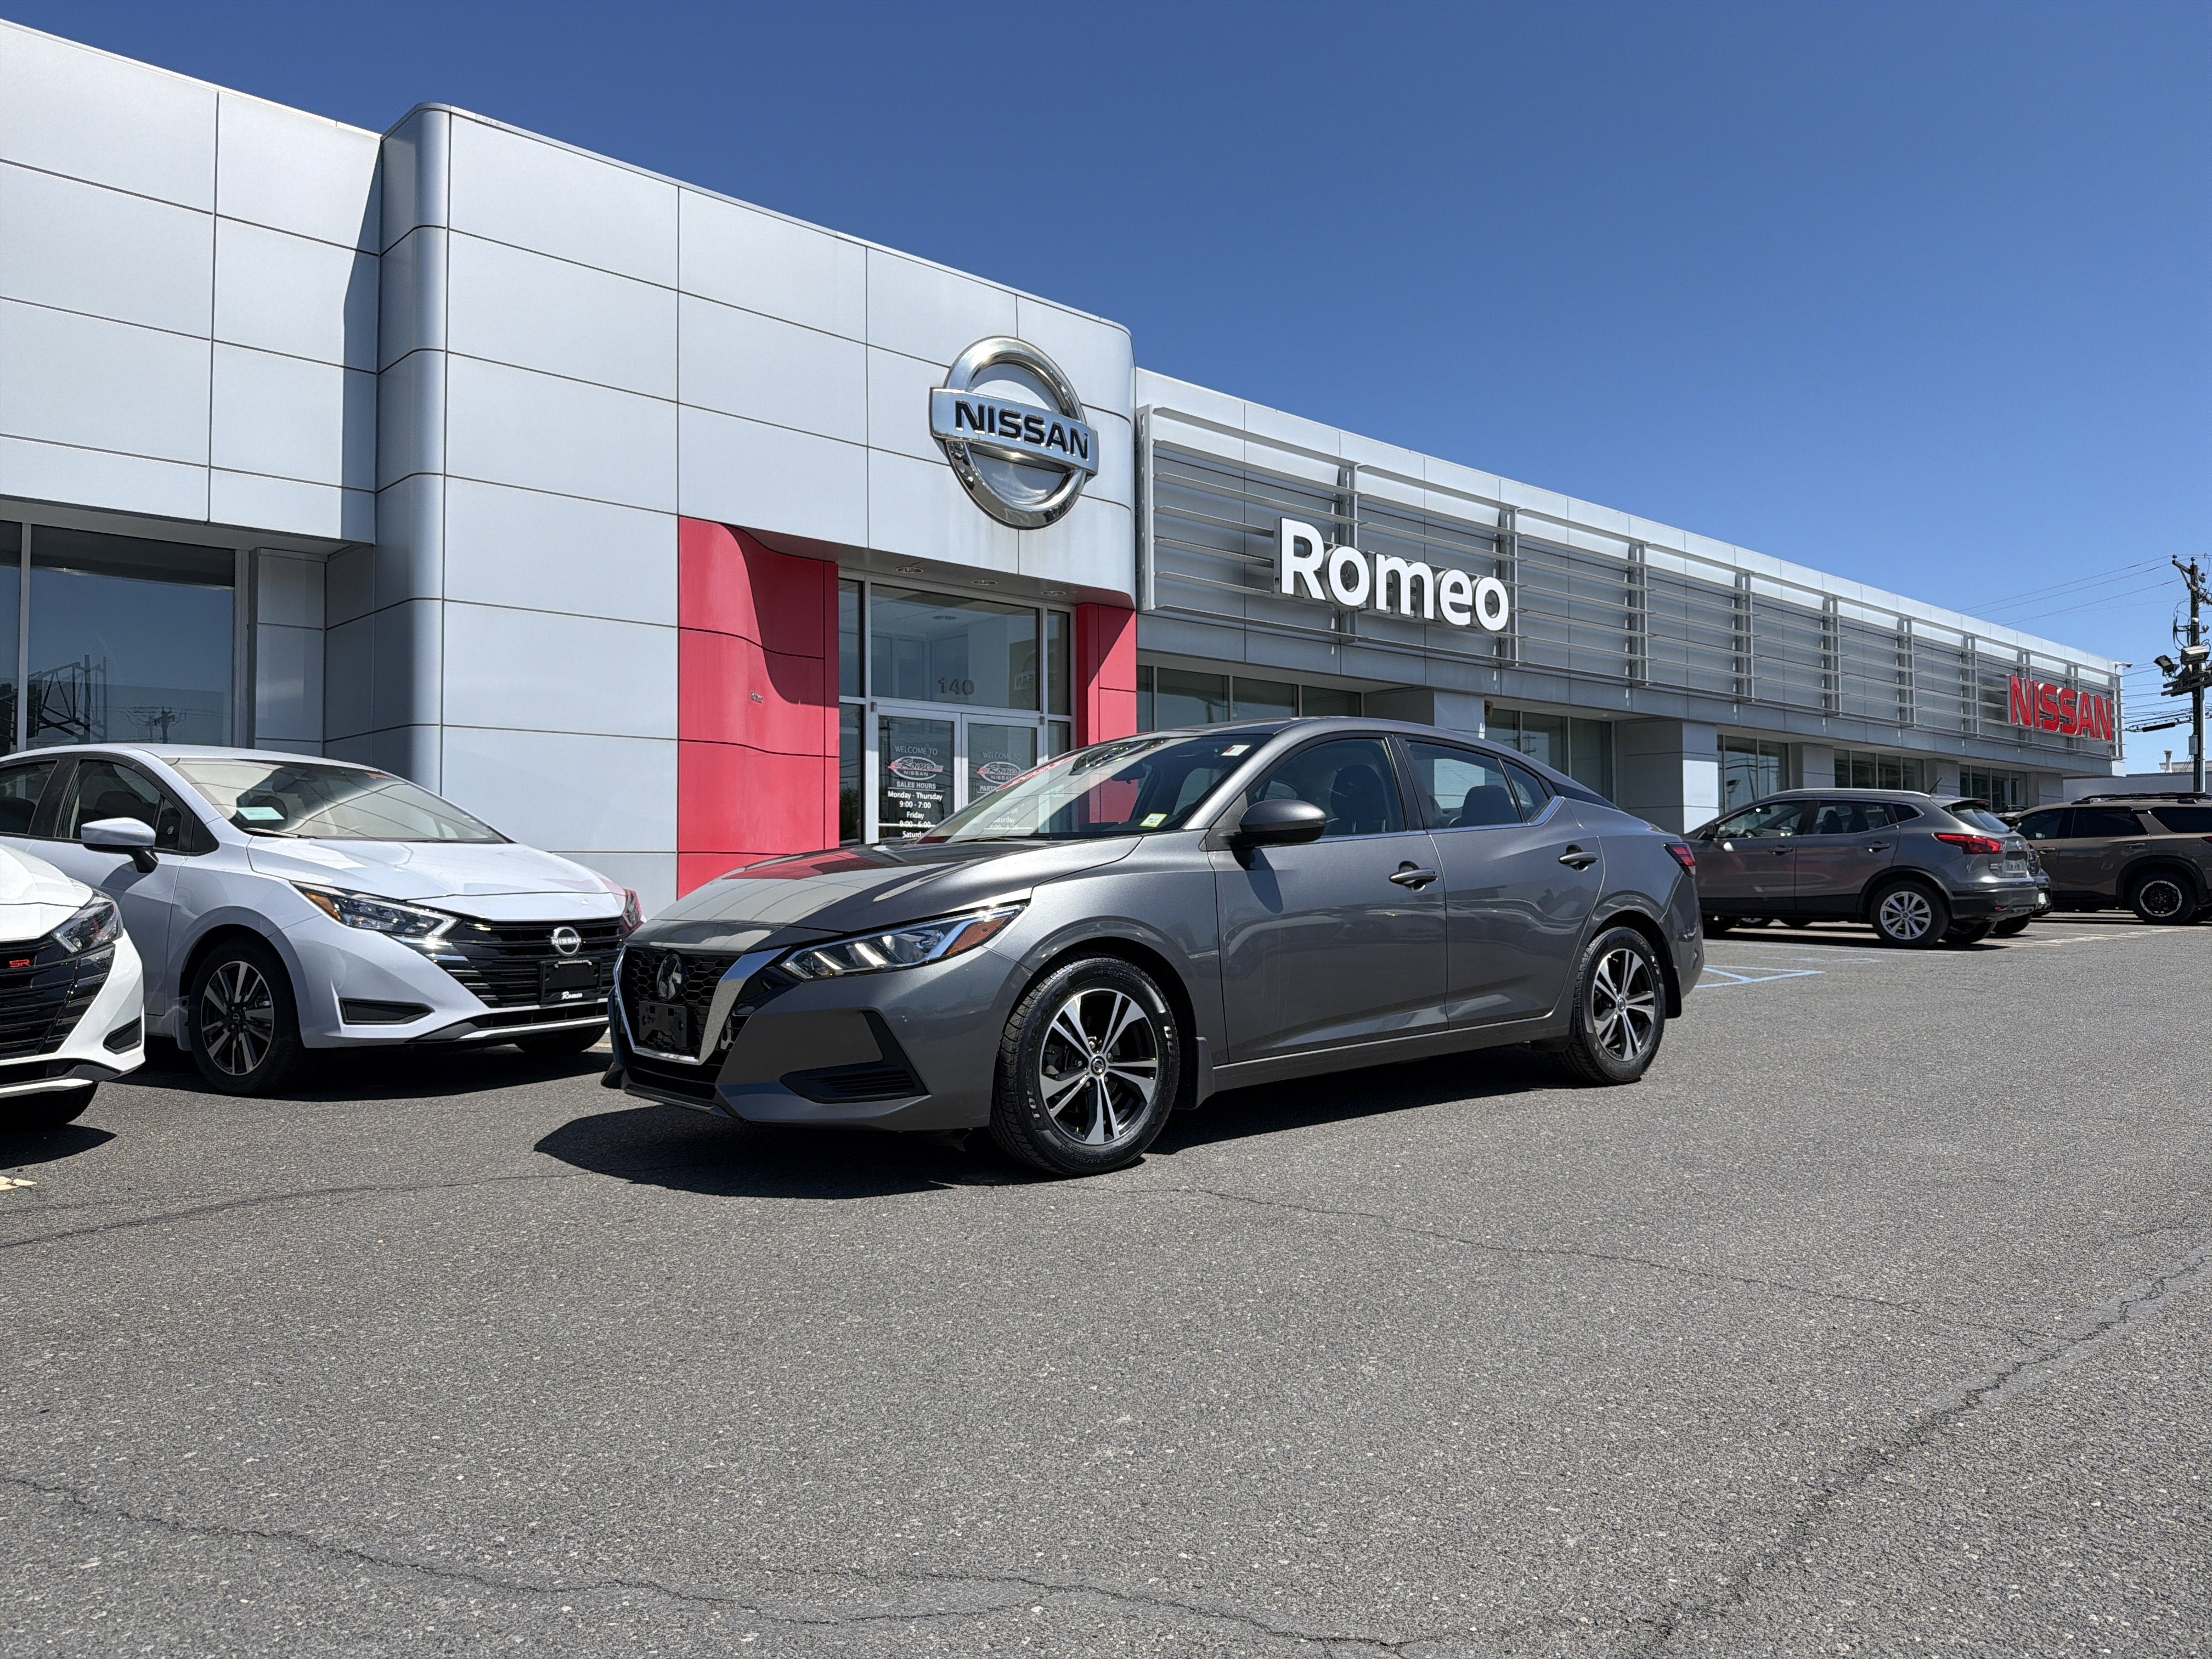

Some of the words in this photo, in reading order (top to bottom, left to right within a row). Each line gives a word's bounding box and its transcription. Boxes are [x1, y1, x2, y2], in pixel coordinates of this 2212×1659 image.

[954, 399, 1090, 462] NISSAN
[1279, 517, 1509, 631] Romeo
[938, 677, 975, 696] 140
[2009, 675, 2112, 741] NISSAN
[895, 746, 927, 755] WELCOME
[898, 758, 935, 771] Romeo
[888, 791, 911, 800] Monday
[916, 792, 943, 802] Thursday
[906, 811, 924, 820] Friday
[8, 959, 31, 968] SR
